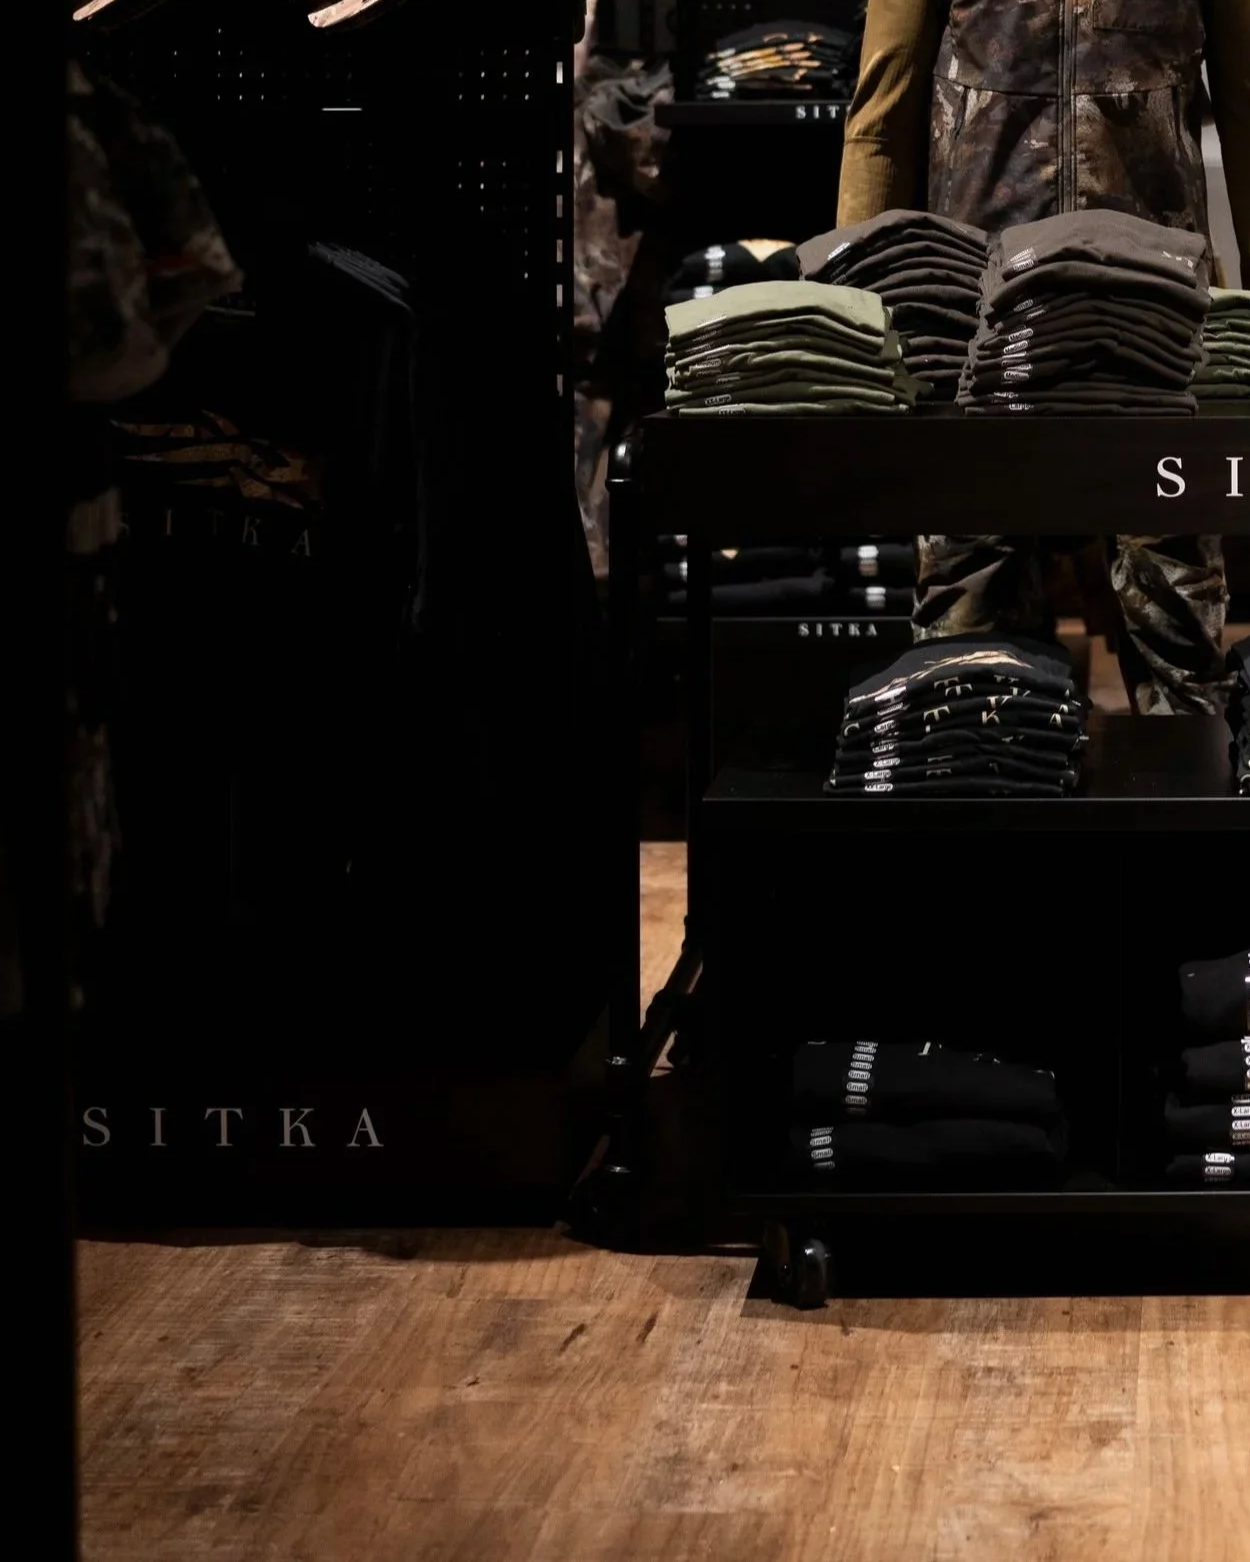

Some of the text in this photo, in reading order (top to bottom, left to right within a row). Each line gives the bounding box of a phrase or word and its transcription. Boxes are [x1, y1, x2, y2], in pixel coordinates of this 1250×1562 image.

[796, 105, 851, 119] SIT
[798, 622, 879, 637] SITKA
[82, 1107, 384, 1147] SITKA
